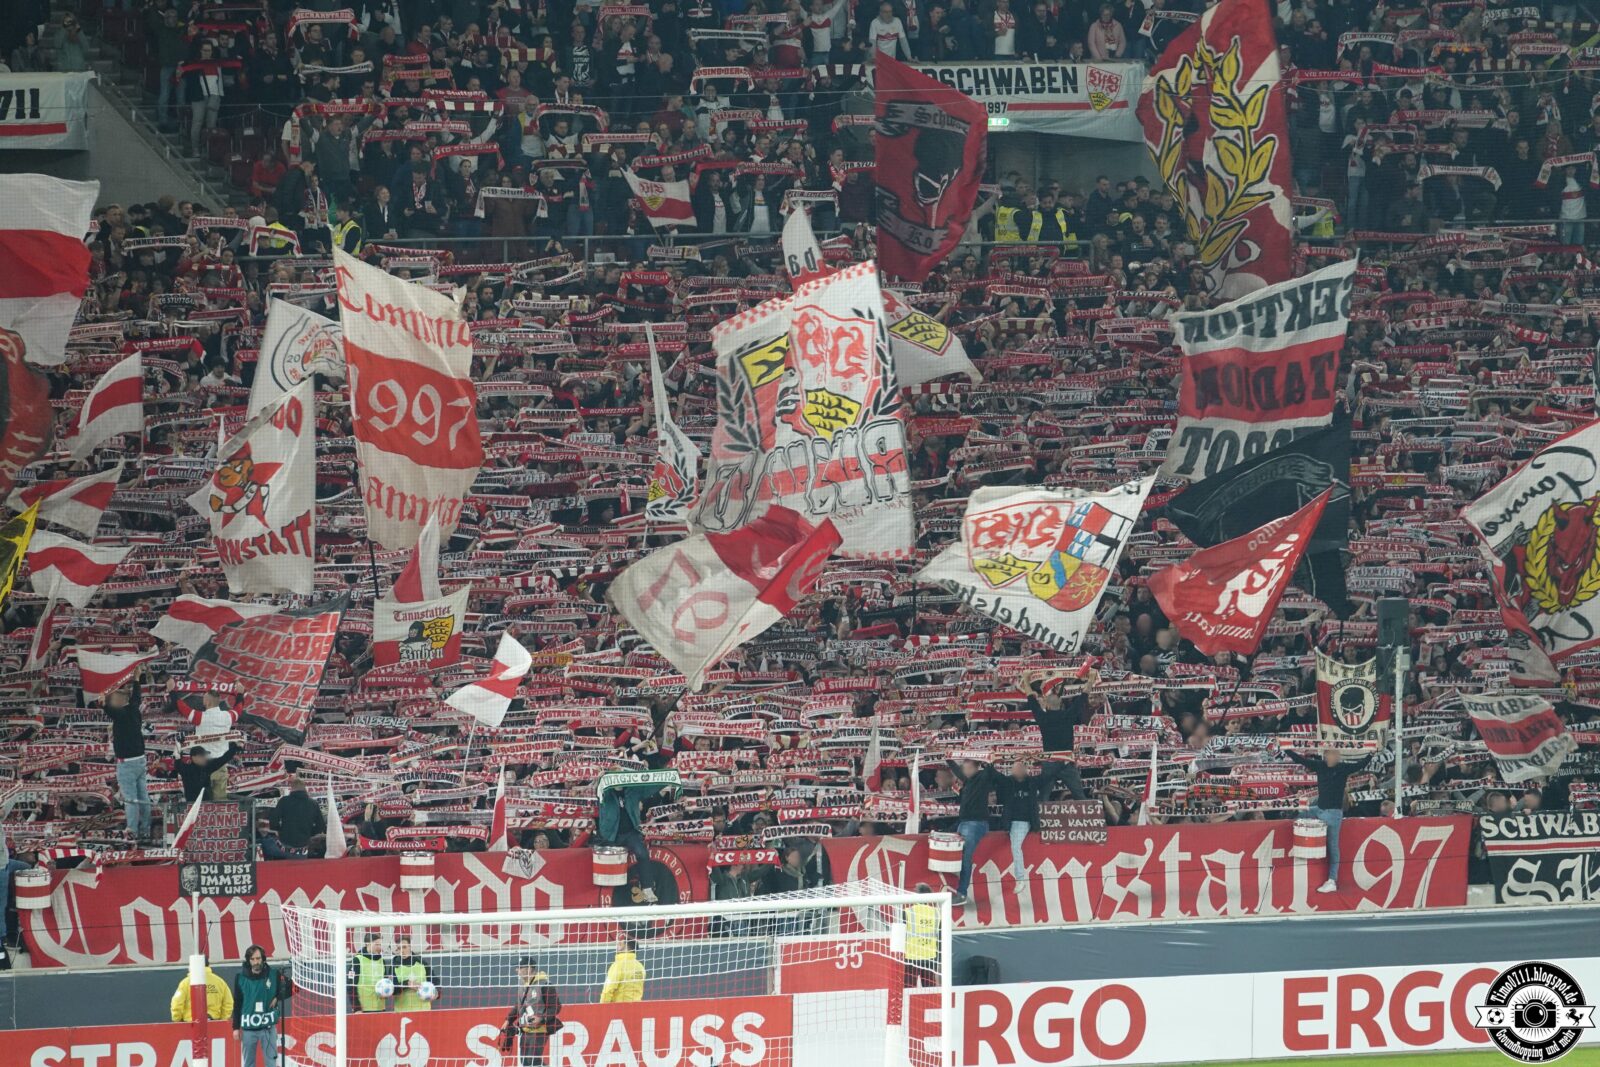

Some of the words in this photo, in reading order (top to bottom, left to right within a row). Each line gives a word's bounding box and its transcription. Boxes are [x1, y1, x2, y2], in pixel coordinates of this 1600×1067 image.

[105, 577, 163, 590] ANNSTATTER
[696, 793, 759, 807] COMMANDO
[554, 805, 577, 815] CC
[1159, 805, 1229, 815] COMMANDO
[769, 823, 828, 839] COMMANDO
[715, 852, 735, 863] CC
[756, 851, 776, 861] 97
[201, 864, 219, 874] DU
[224, 864, 252, 874] BIST
[1352, 824, 1455, 911] 97
[201, 875, 252, 885] IMMER
[201, 886, 221, 894] BEI
[224, 885, 252, 894] UNS!
[835, 943, 864, 972] 35
[1283, 968, 1505, 1051] ERGO
[240, 1013, 277, 1028] HOST
[908, 984, 1146, 1066] ERGO
[463, 1010, 766, 1067] SRAUSS
